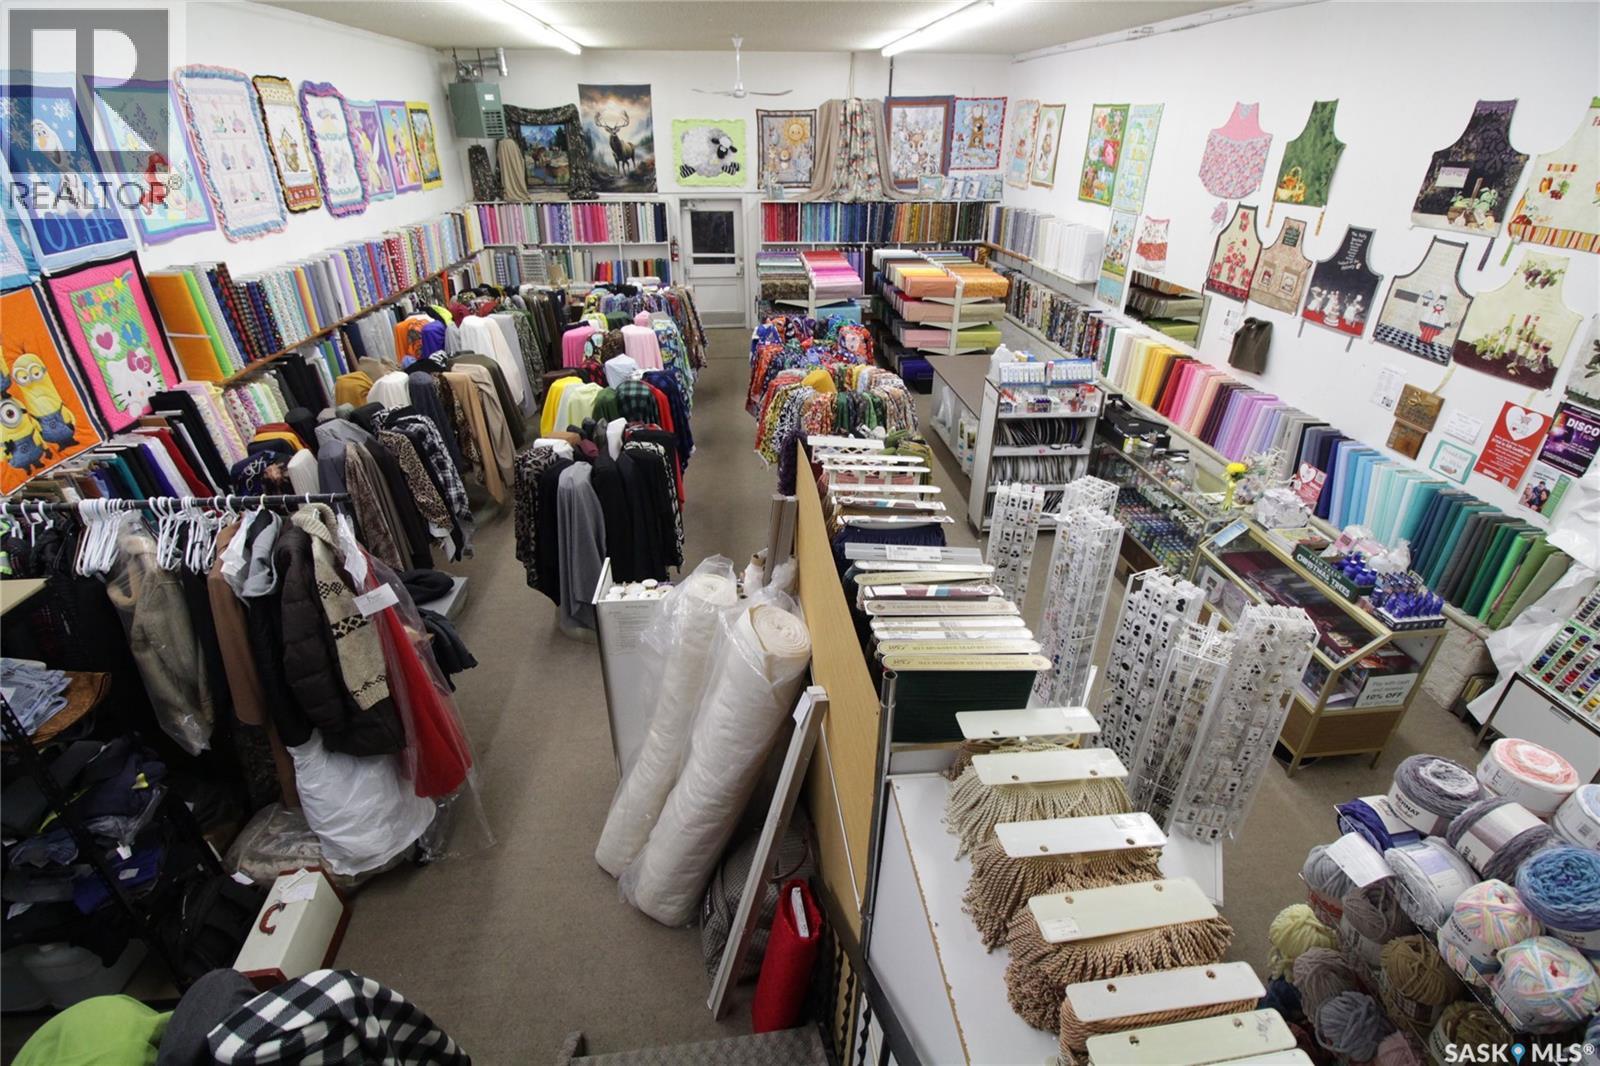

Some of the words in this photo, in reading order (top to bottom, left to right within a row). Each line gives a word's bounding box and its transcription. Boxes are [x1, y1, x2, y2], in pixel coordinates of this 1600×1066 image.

[1566, 417, 1600, 437] DISCO
[1296, 553, 1330, 581] CHRISTMAS
[1331, 578, 1351, 598] TREES
